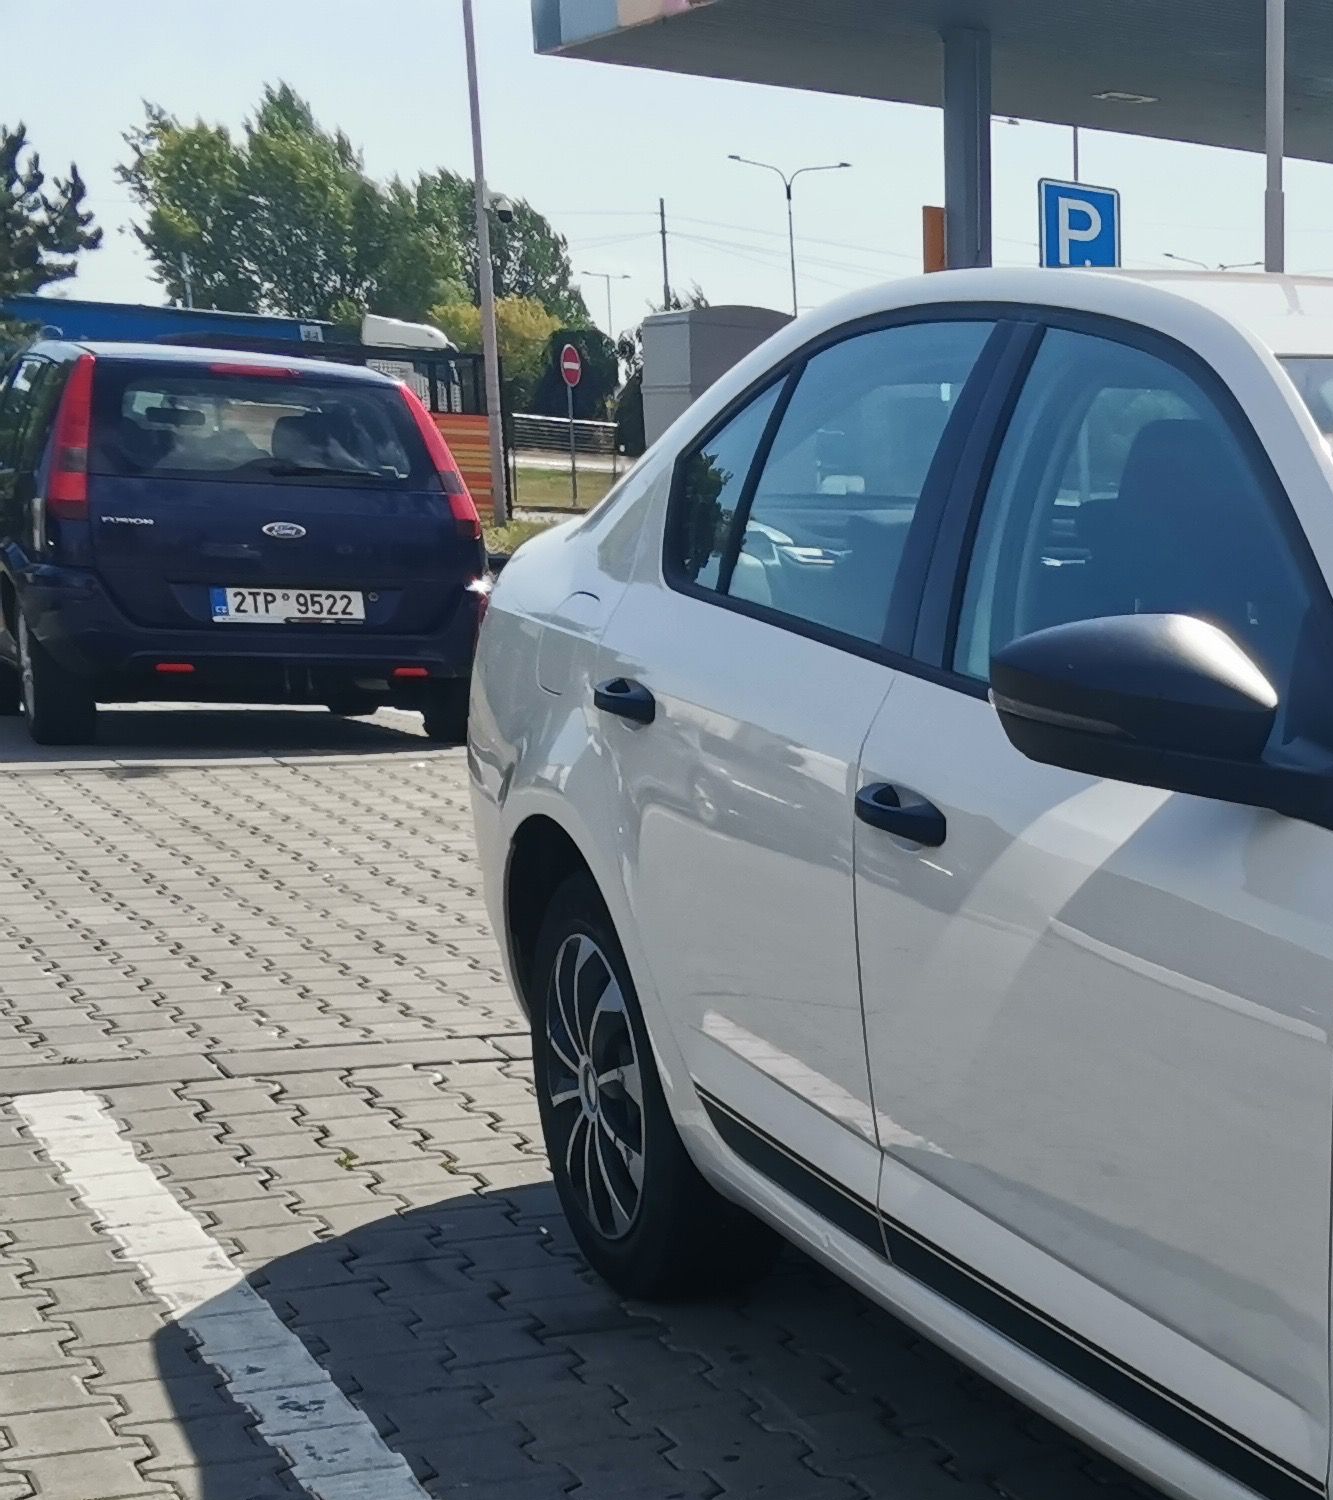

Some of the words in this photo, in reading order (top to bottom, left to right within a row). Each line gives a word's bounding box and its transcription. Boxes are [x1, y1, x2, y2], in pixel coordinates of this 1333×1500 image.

[1058, 196, 1102, 265] P
[233, 591, 277, 614] 2TP
[295, 592, 354, 616] 9522
